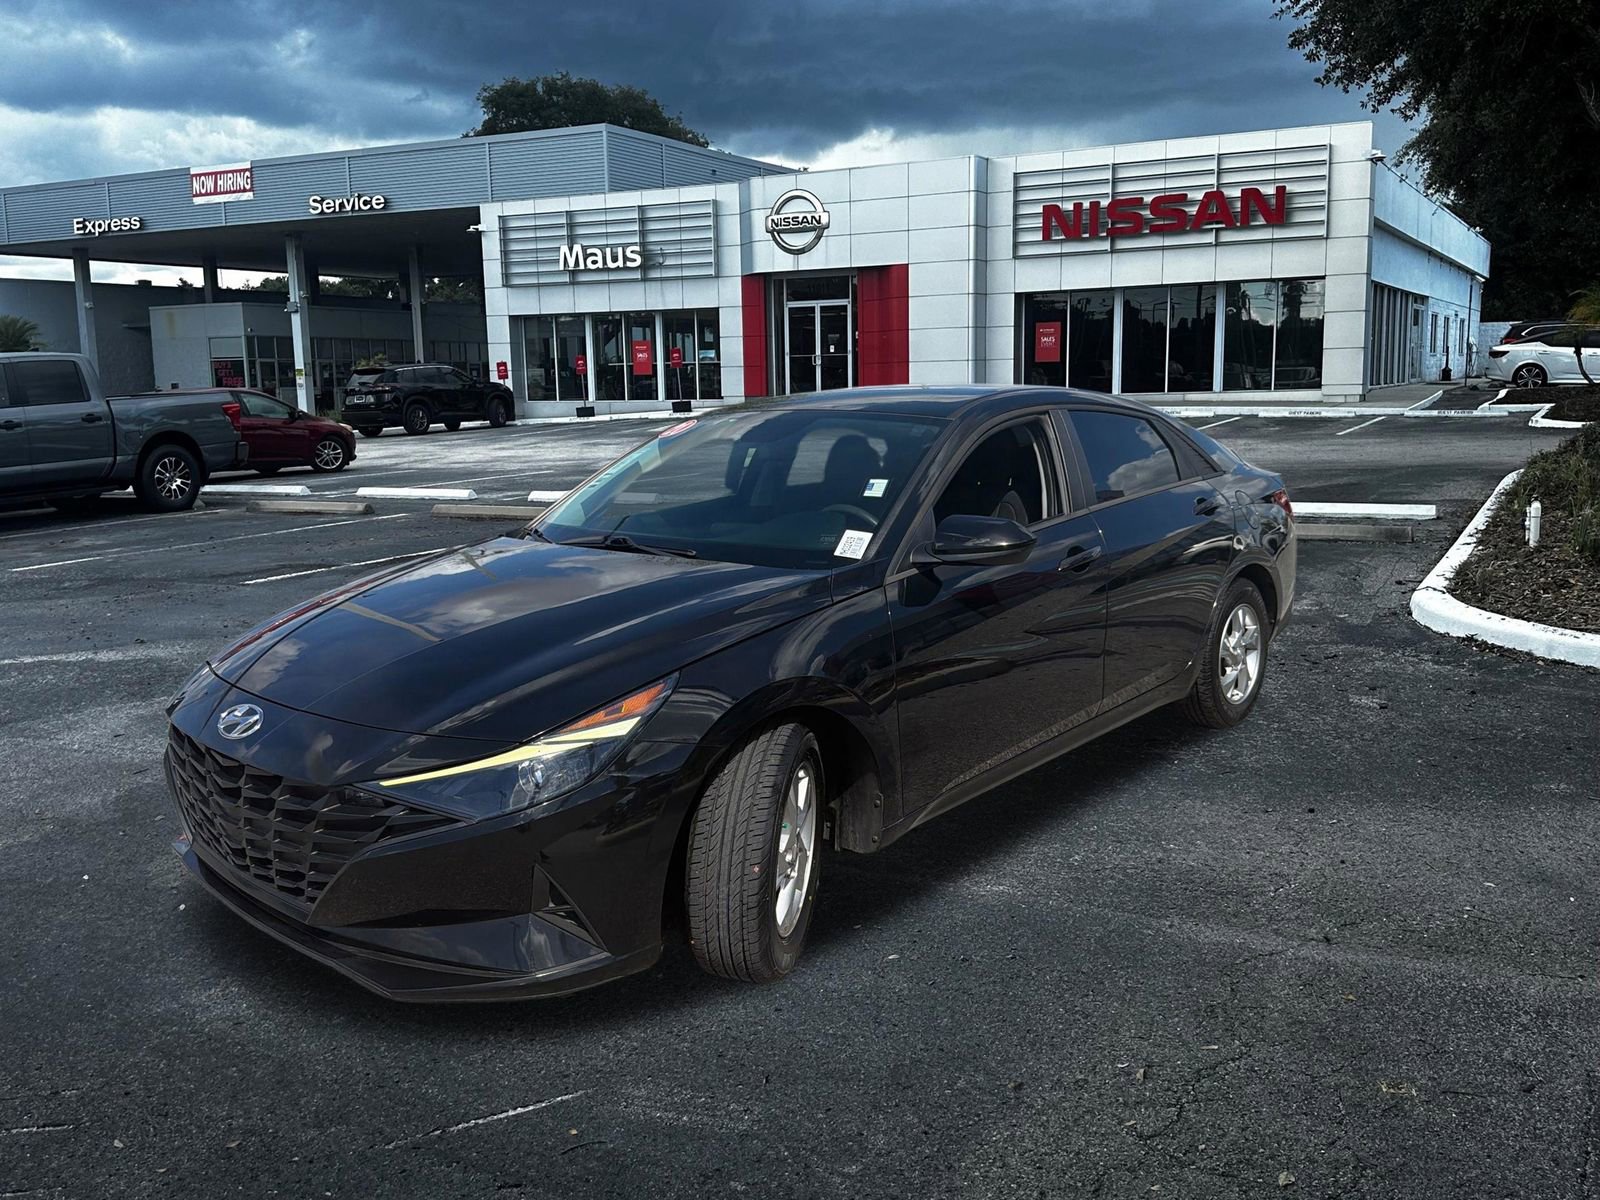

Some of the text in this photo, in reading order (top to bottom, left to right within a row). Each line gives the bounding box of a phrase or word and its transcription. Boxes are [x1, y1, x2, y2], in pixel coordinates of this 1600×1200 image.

[192, 171, 251, 195] NOW HIRING
[308, 193, 386, 216] Service
[1042, 185, 1286, 241] NISSAN
[73, 216, 141, 236] Express
[770, 215, 822, 228] NISSAN
[559, 243, 642, 271] Maus
[223, 377, 243, 386] FREE
